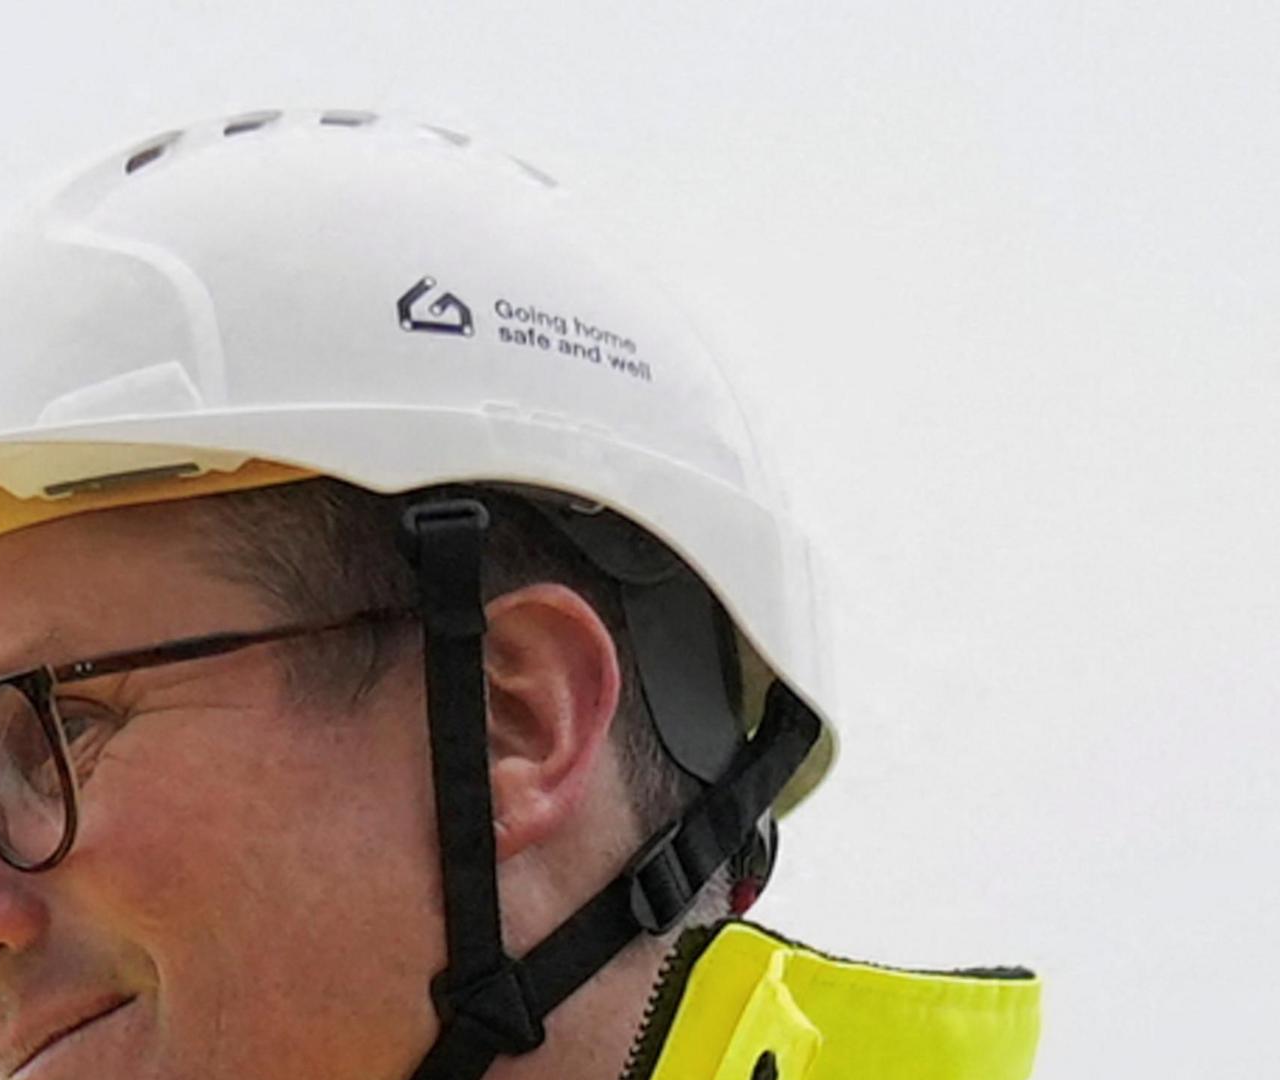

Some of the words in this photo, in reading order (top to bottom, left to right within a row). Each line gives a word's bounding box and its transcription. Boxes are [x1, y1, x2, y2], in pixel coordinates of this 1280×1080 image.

[494, 299, 567, 335] Going
[574, 316, 637, 354] home
[498, 326, 551, 350] safe
[558, 339, 601, 363] and
[607, 353, 652, 381] well
